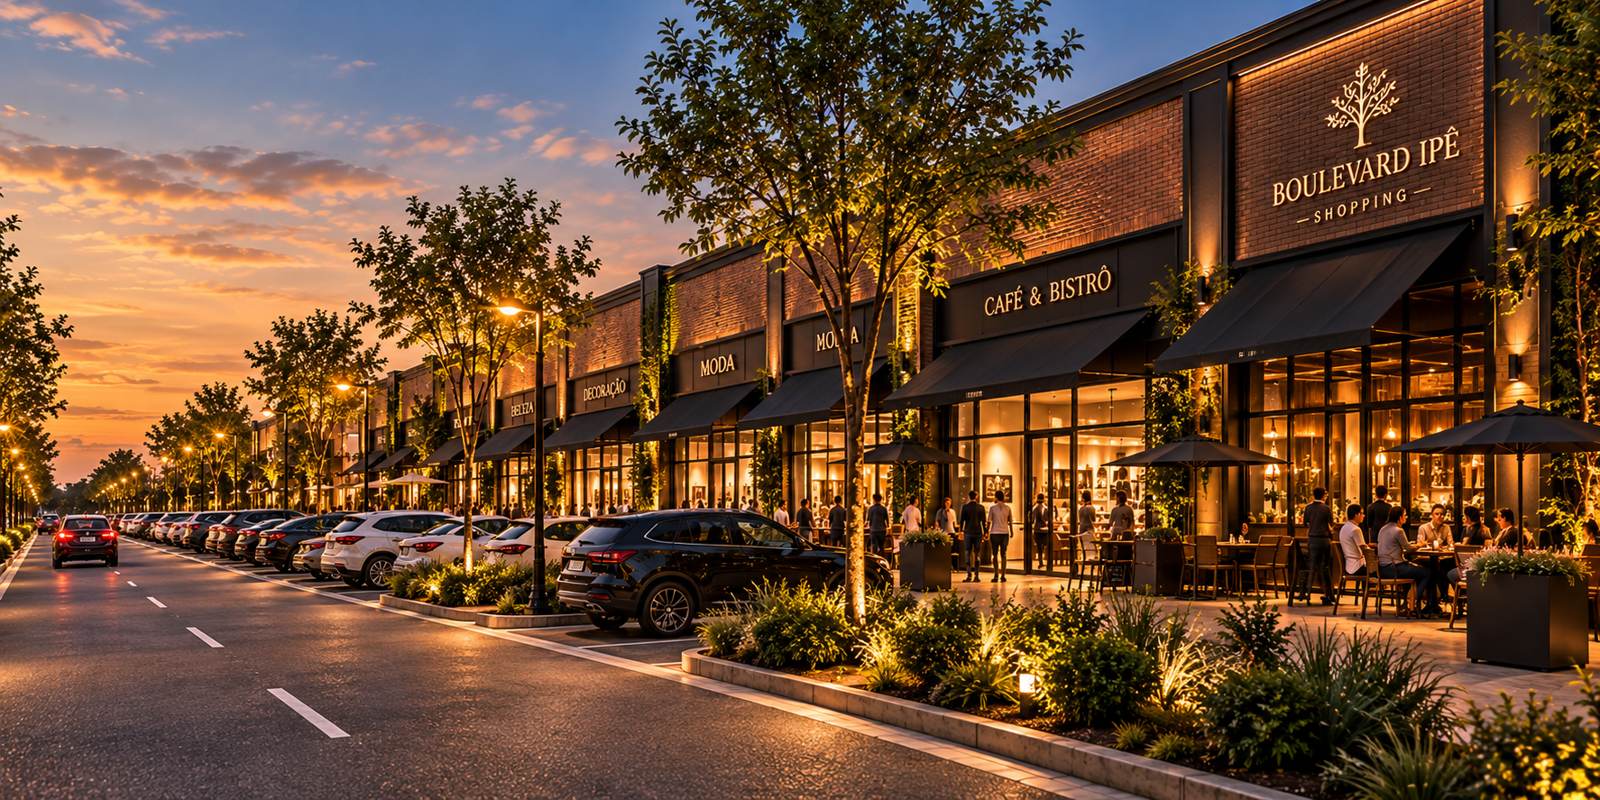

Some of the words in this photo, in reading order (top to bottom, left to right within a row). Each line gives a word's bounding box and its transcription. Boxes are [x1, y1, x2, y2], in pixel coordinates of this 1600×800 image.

[1272, 146, 1411, 207] BOULEVARD
[1418, 126, 1460, 167] IPÊ
[1313, 188, 1407, 224] SHOPPING
[984, 285, 1023, 316] CAFÉ
[1029, 286, 1042, 306] &
[1049, 264, 1112, 303] BISTRÔ
[700, 353, 735, 377] MODA
[511, 401, 534, 418] BELEZA
